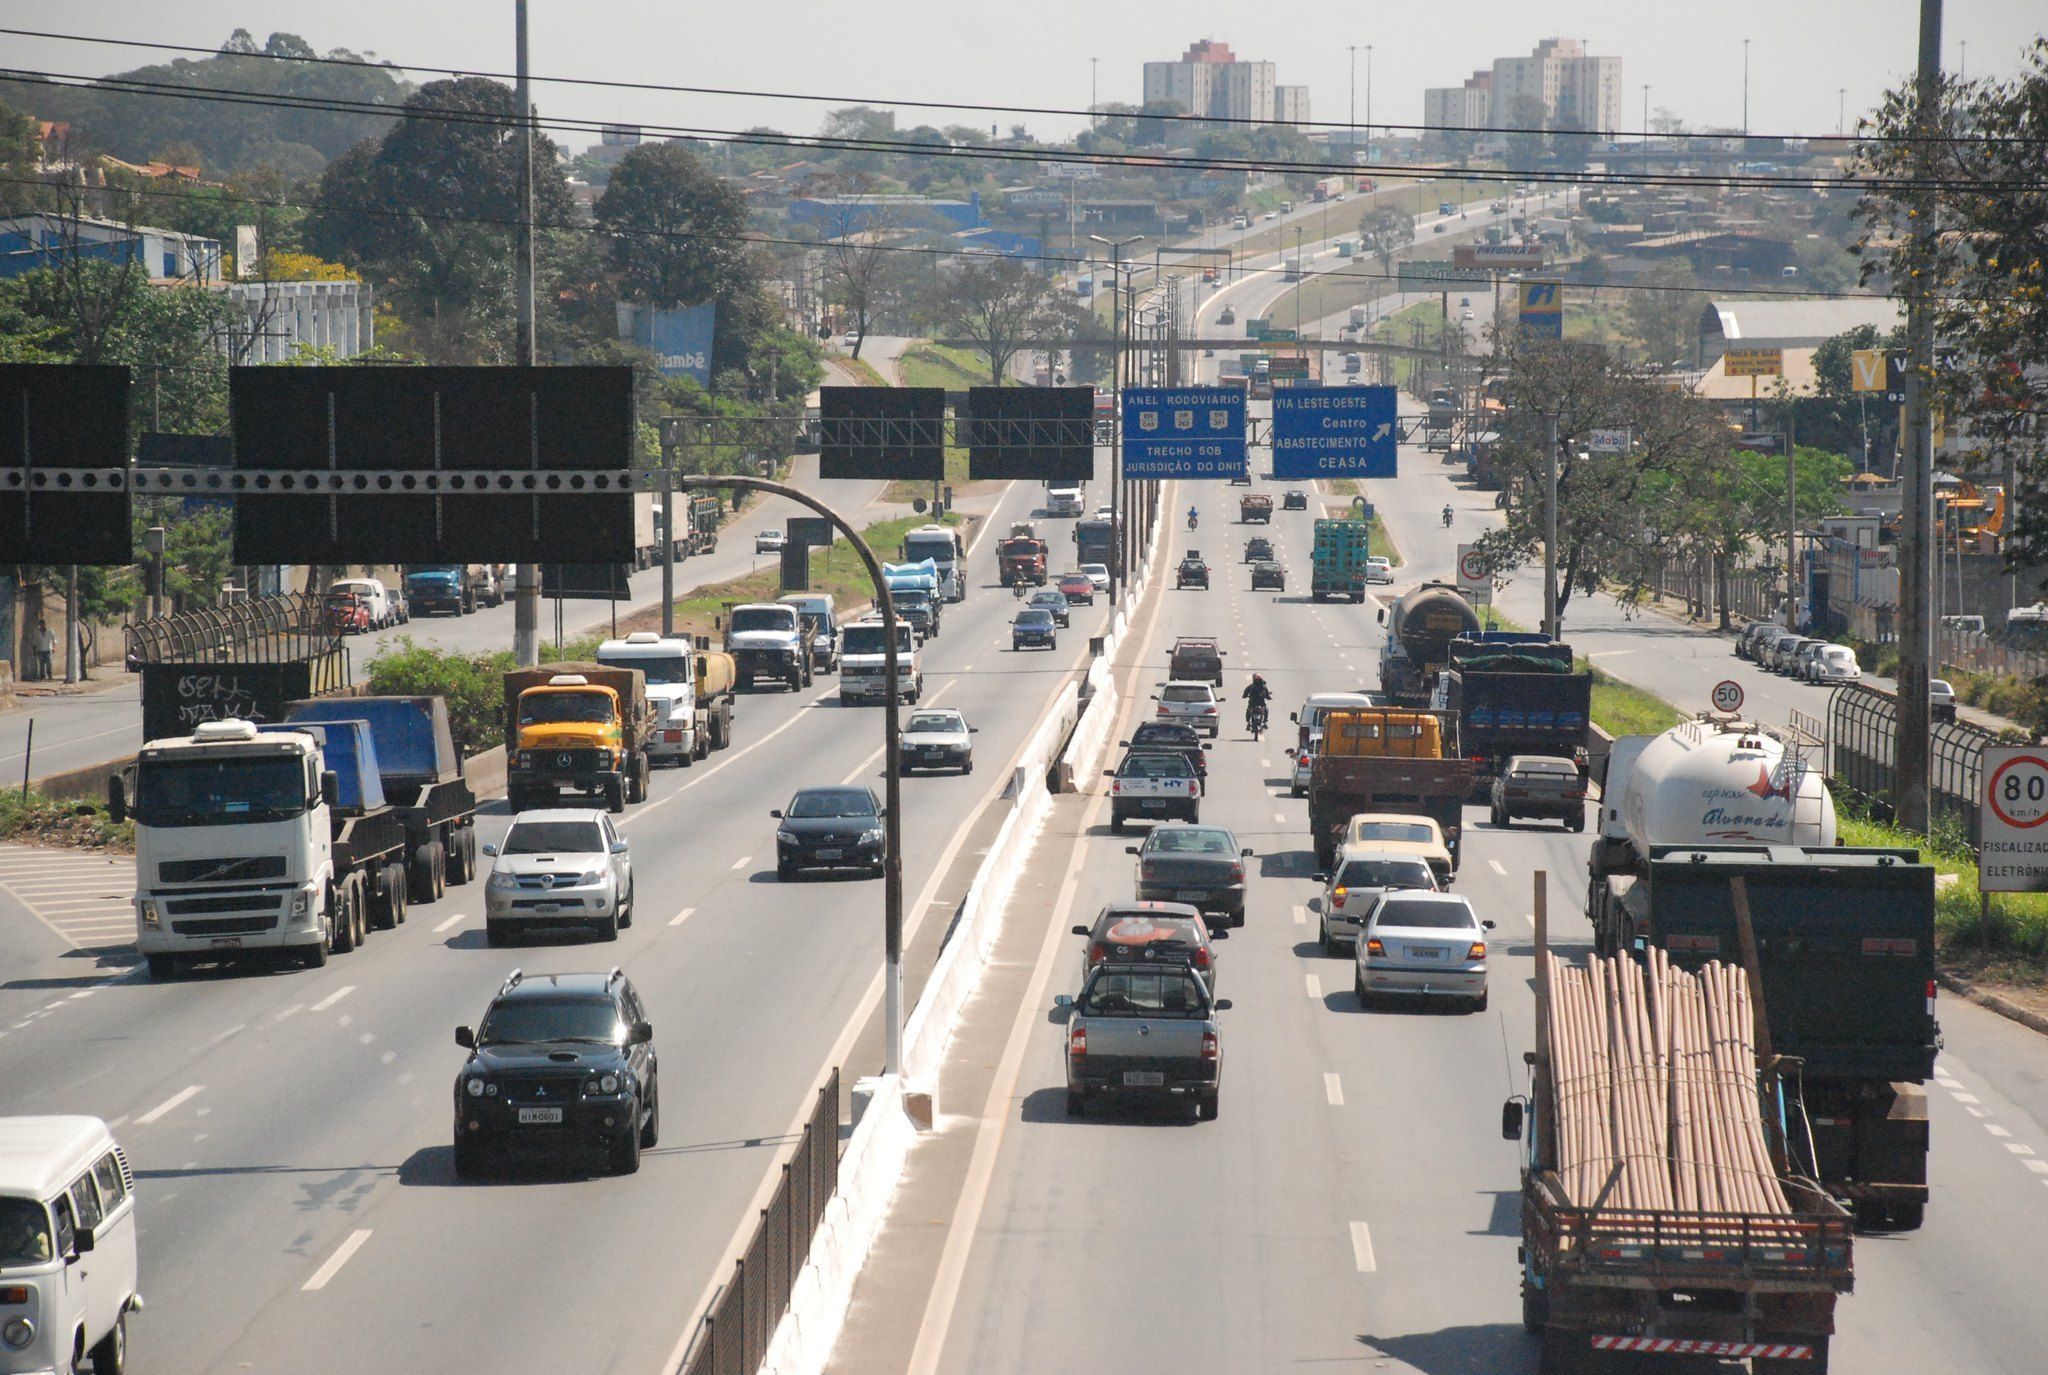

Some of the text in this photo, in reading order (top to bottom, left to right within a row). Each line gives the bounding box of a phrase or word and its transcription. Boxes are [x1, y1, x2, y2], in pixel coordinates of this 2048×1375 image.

[1128, 395, 1159, 405] ANEL
[1275, 397, 1367, 409] VIA LESTE OESTE
[1322, 417, 1367, 428] Centro
[1276, 437, 1367, 449] ABASTECIMENTO
[1147, 446, 1222, 456] TRECHO SOB
[1126, 461, 1242, 473] JURISDIÇÃO DO DNIT
[1319, 457, 1367, 469] CEASA
[1717, 687, 1738, 702] 50
[2004, 774, 2045, 801] 80
[2009, 808, 2041, 817] km/h
